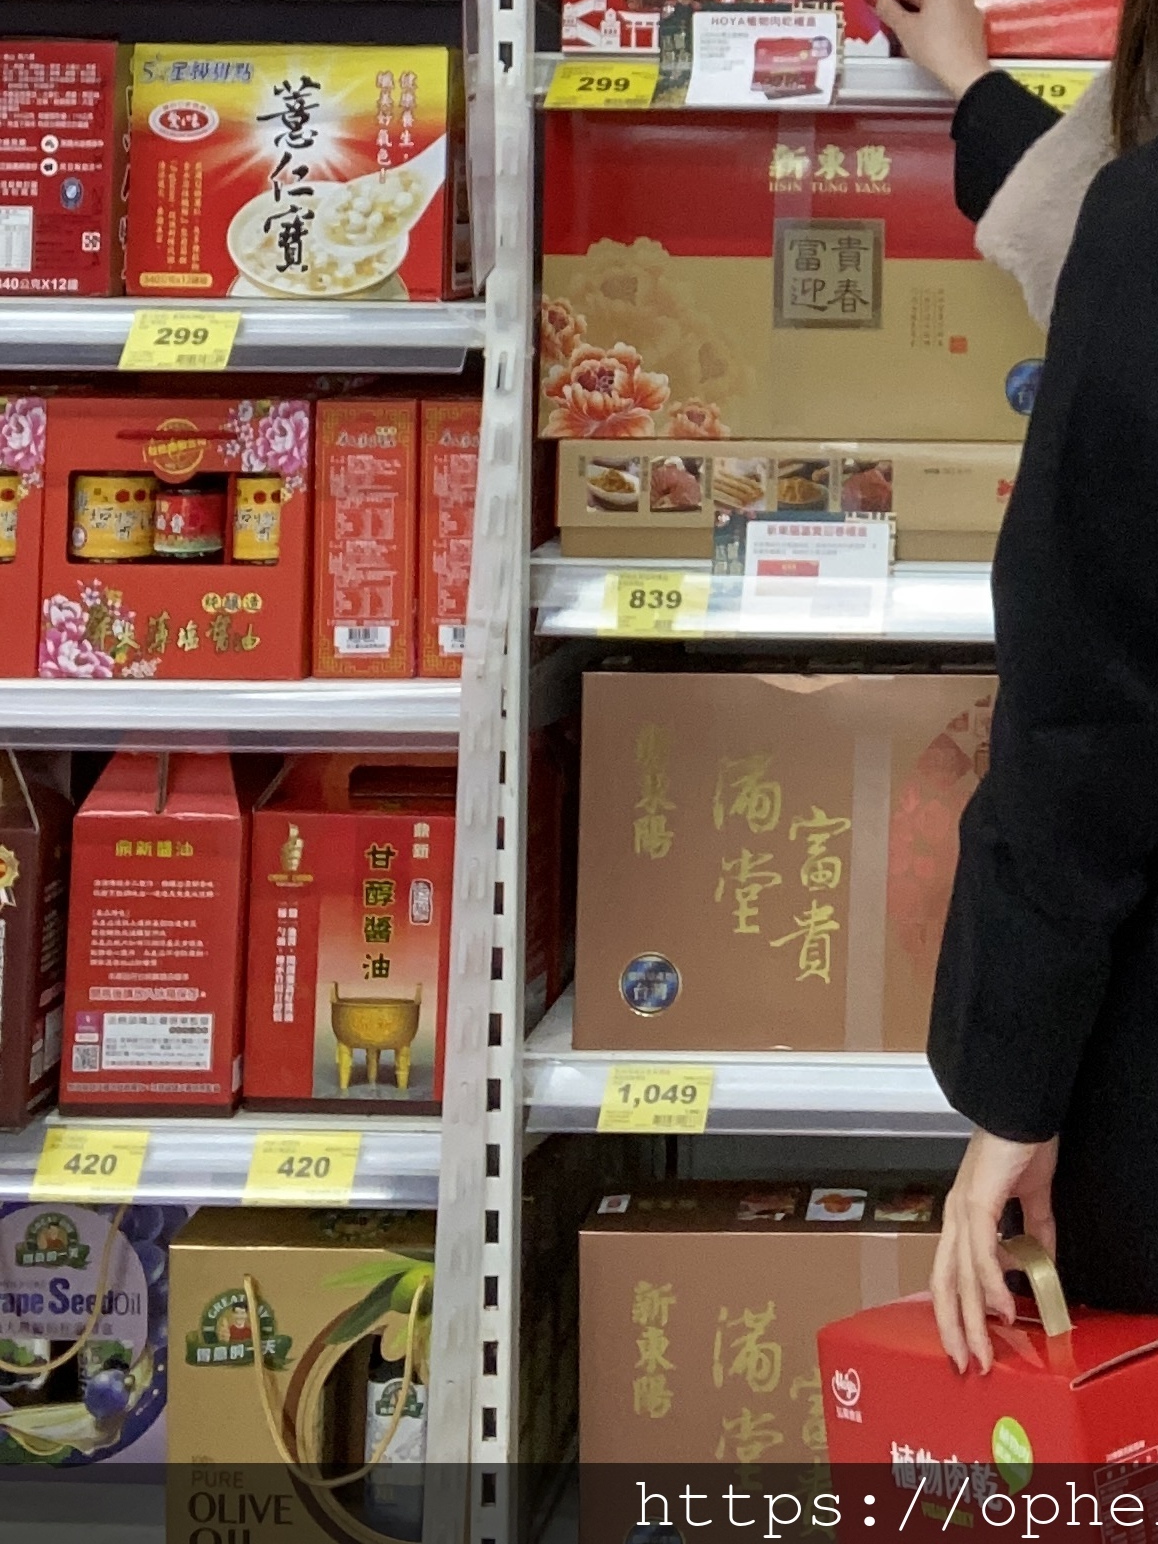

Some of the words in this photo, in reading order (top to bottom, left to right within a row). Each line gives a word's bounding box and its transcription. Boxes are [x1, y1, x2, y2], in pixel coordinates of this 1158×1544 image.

[576, 76, 631, 92] 299
[257, 75, 321, 273] 薏仁寶
[769, 143, 892, 181] 新東陽
[769, 181, 801, 193] HSIN
[812, 181, 847, 194] TUNG
[854, 182, 892, 194] YANG
[789, 237, 871, 273] 富貴
[791, 277, 871, 314] 迎春
[154, 327, 209, 346] 299
[629, 589, 682, 609] 839
[769, 805, 852, 984] 富貴
[616, 1082, 697, 1107] 1,049
[63, 1153, 118, 1177] 420
[277, 1156, 331, 1178] 420
[0, 1292, 44, 1317] ape
[115, 1290, 141, 1315] Oil
[632, 1280, 677, 1419] 新東陽
[191, 1470, 244, 1489] PURE
[889, 1440, 1003, 1512] 植物肉乾
[187, 1490, 294, 1525] OLIVE
